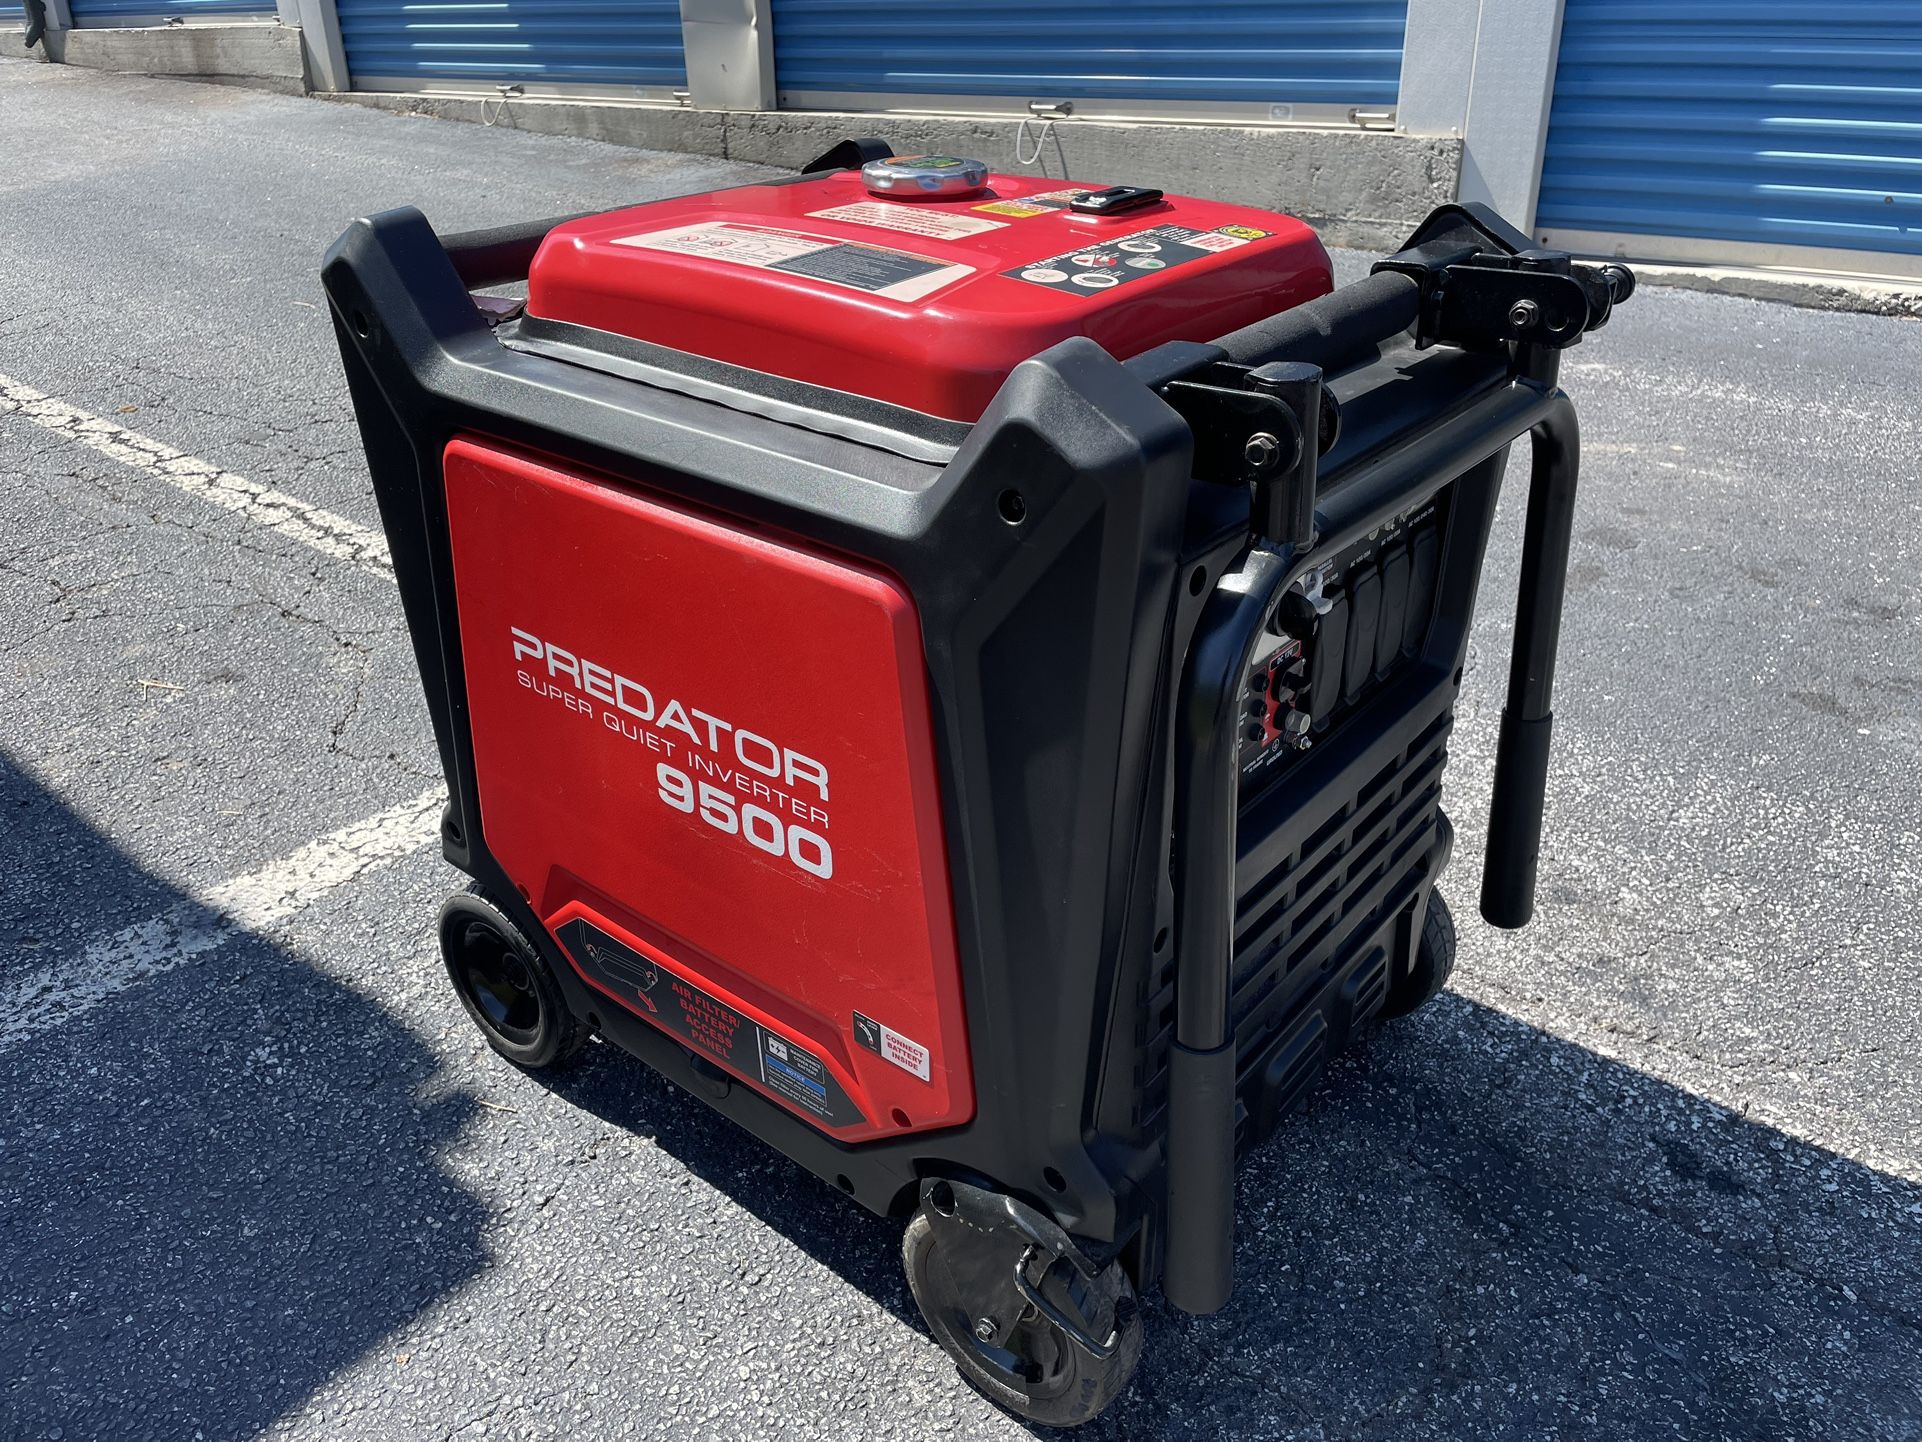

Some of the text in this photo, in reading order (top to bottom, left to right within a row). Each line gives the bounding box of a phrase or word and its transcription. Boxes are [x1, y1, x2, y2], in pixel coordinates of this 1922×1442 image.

[1025, 249, 1080, 269] STARTING
[1100, 228, 1158, 247] GENERATOR
[511, 626, 829, 801] PREDATOR
[517, 670, 829, 829] SUPER QUIET INVERTER
[656, 762, 833, 880] 9500
[671, 982, 741, 1028] AIR FILTER/
[679, 998, 734, 1037] BATTERY
[685, 1014, 733, 1049] ACCESS
[691, 1029, 730, 1059] PANEL
[885, 1033, 924, 1058] CONNECT
[887, 1042, 923, 1065] BATTERY
[891, 1051, 919, 1071] INSIDE
[785, 1067, 806, 1083] NOTICE
